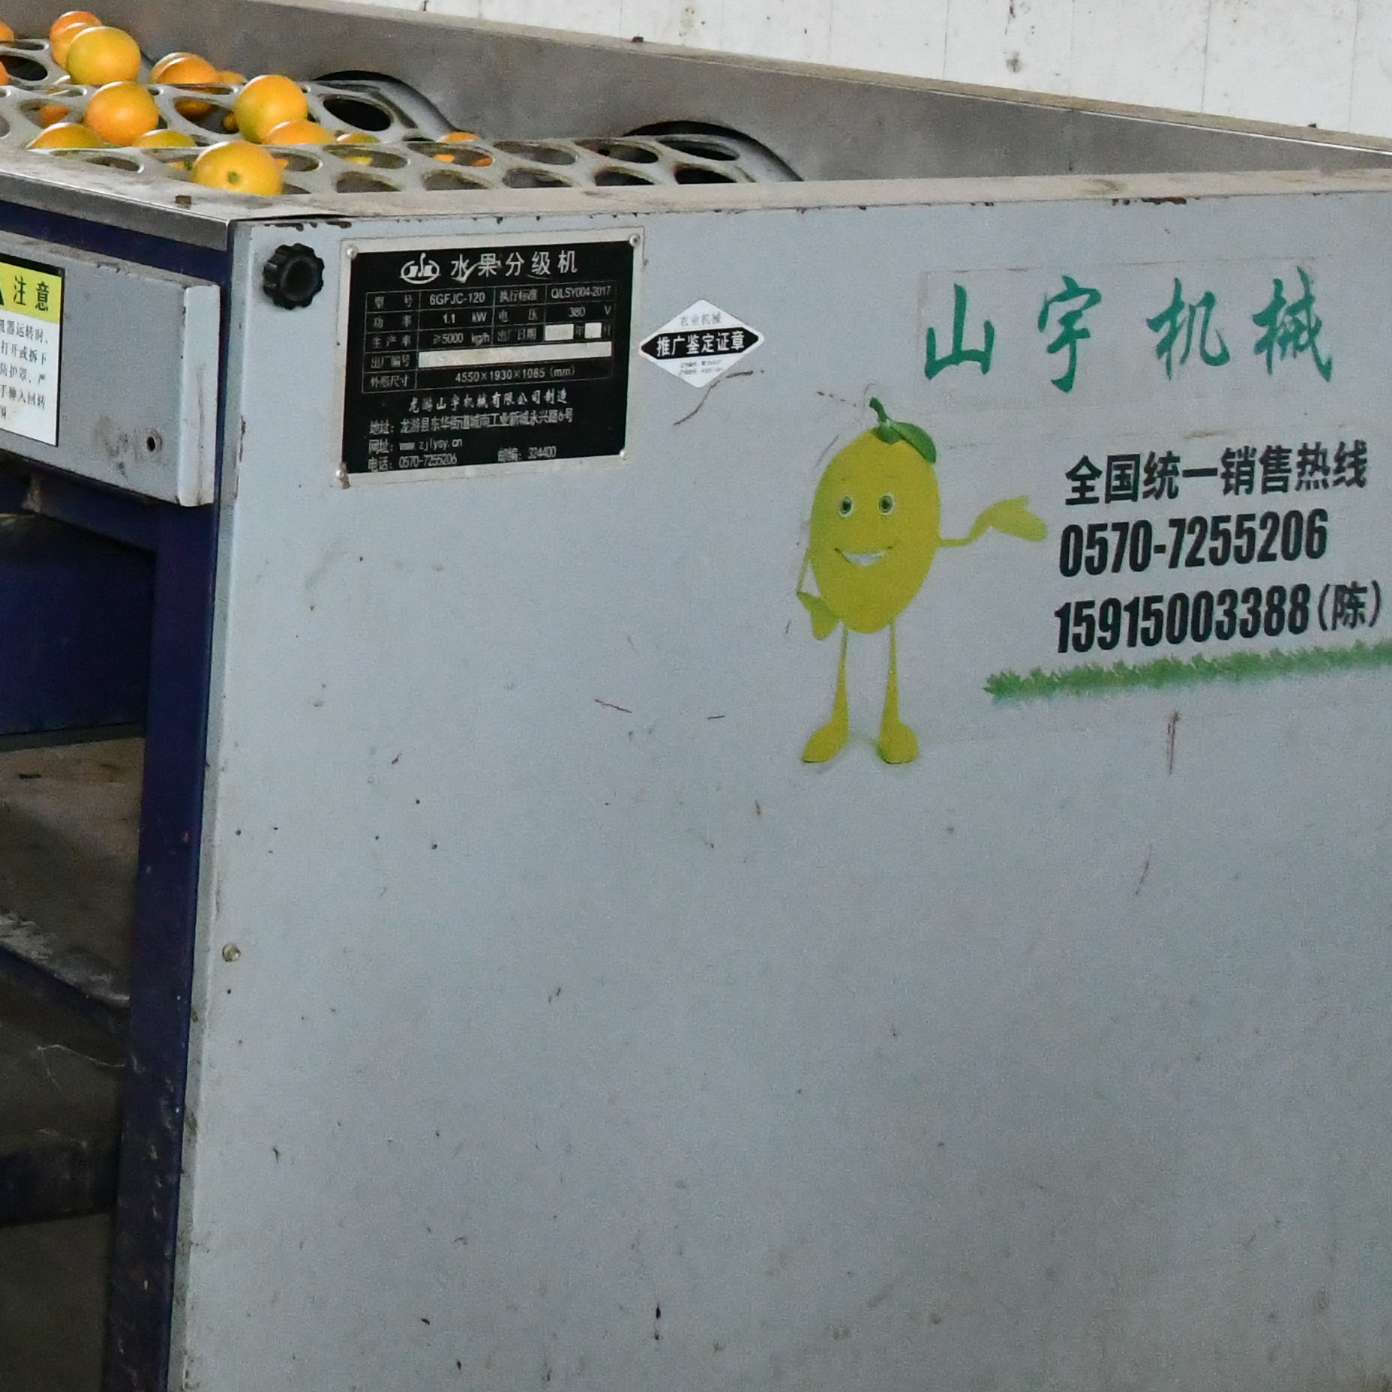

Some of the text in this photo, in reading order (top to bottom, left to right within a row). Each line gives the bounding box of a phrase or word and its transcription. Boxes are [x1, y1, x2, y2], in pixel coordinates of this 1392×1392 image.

[450, 249, 579, 278] 水果分级机
[13, 274, 50, 311] 注意
[429, 292, 486, 306] 6GFJC-120
[568, 306, 586, 318] 380
[604, 304, 612, 315] V
[656, 329, 745, 358] 推广鉴定证章
[923, 265, 1333, 394] 山宇机械
[1065, 439, 1369, 506] 全国统一销售热线
[1058, 508, 1328, 578] 0570-7255206
